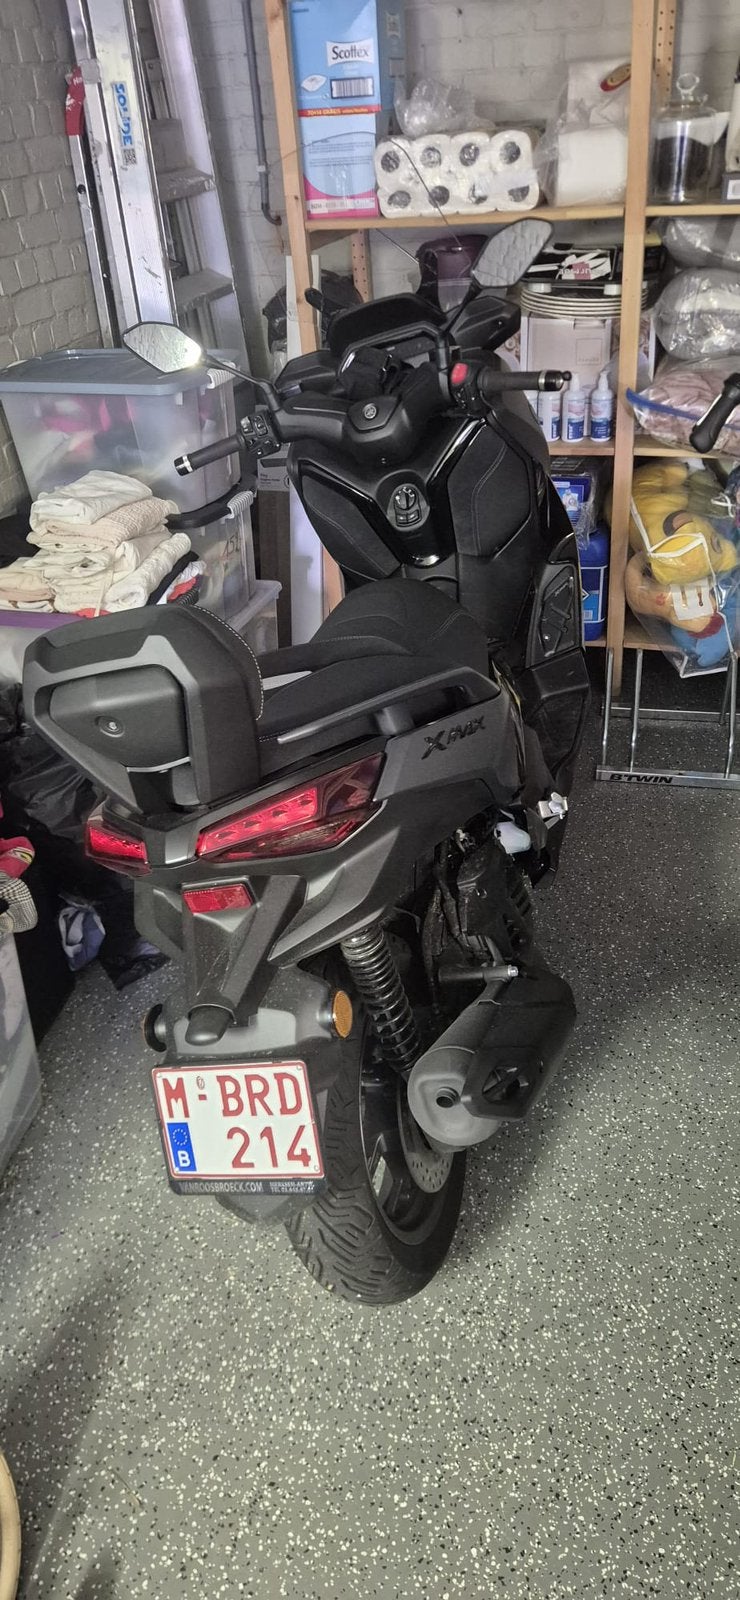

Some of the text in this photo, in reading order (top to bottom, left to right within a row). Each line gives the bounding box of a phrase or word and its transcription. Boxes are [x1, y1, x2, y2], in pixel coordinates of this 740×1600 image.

[331, 46, 369, 60] Scottex
[227, 1124, 311, 1168] 214
[177, 1151, 191, 1167] B
